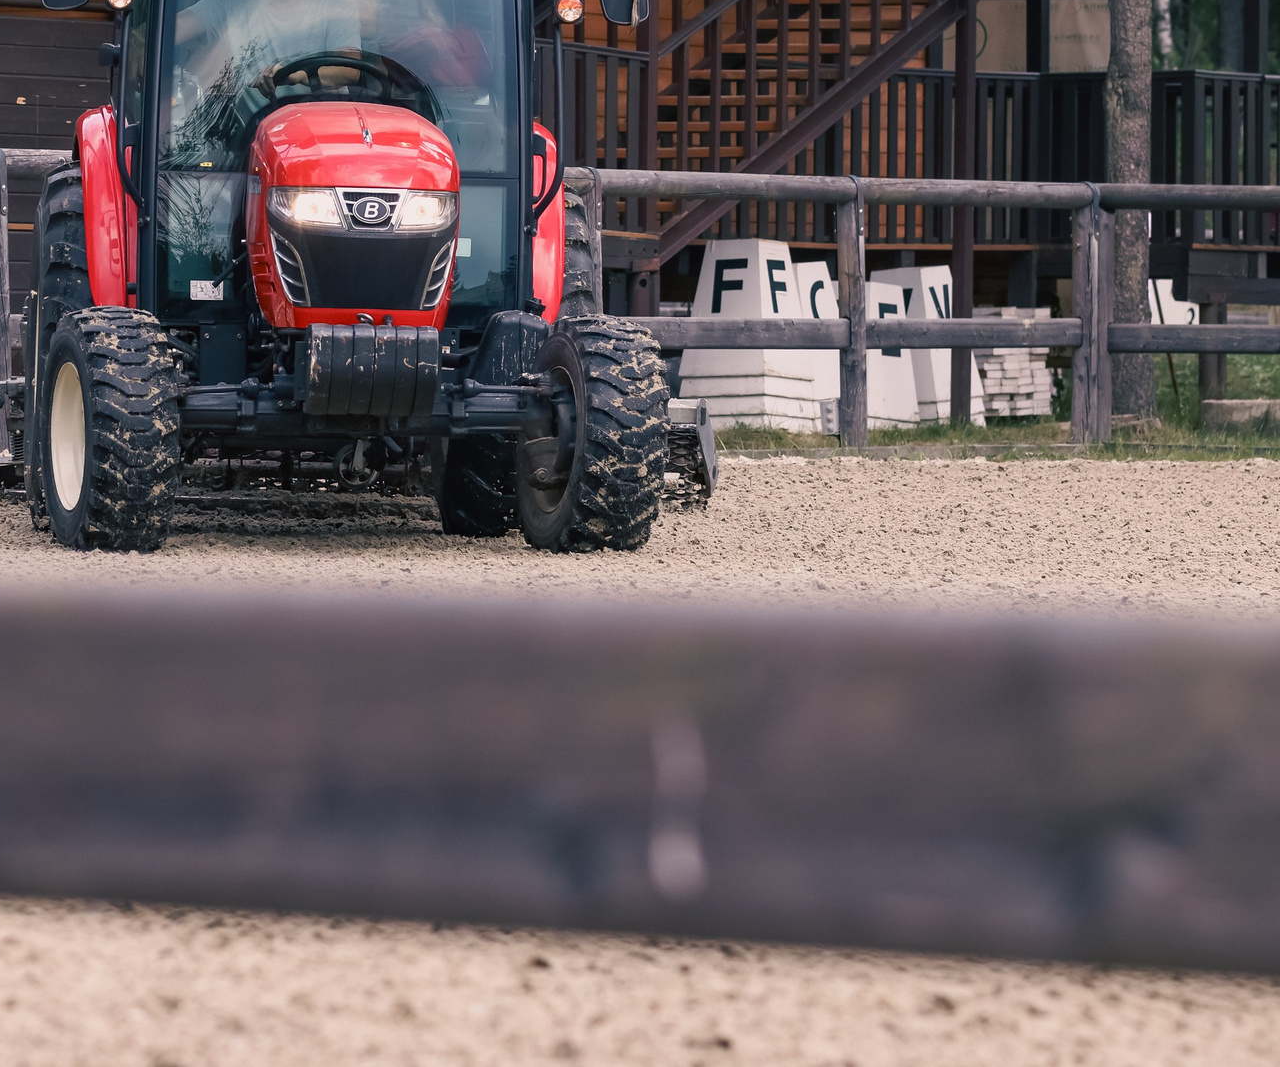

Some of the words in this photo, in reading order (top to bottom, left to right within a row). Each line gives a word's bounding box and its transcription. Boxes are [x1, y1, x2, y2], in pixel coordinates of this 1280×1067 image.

[364, 202, 379, 218] B
[711, 258, 748, 313] F
[766, 259, 787, 313] F
